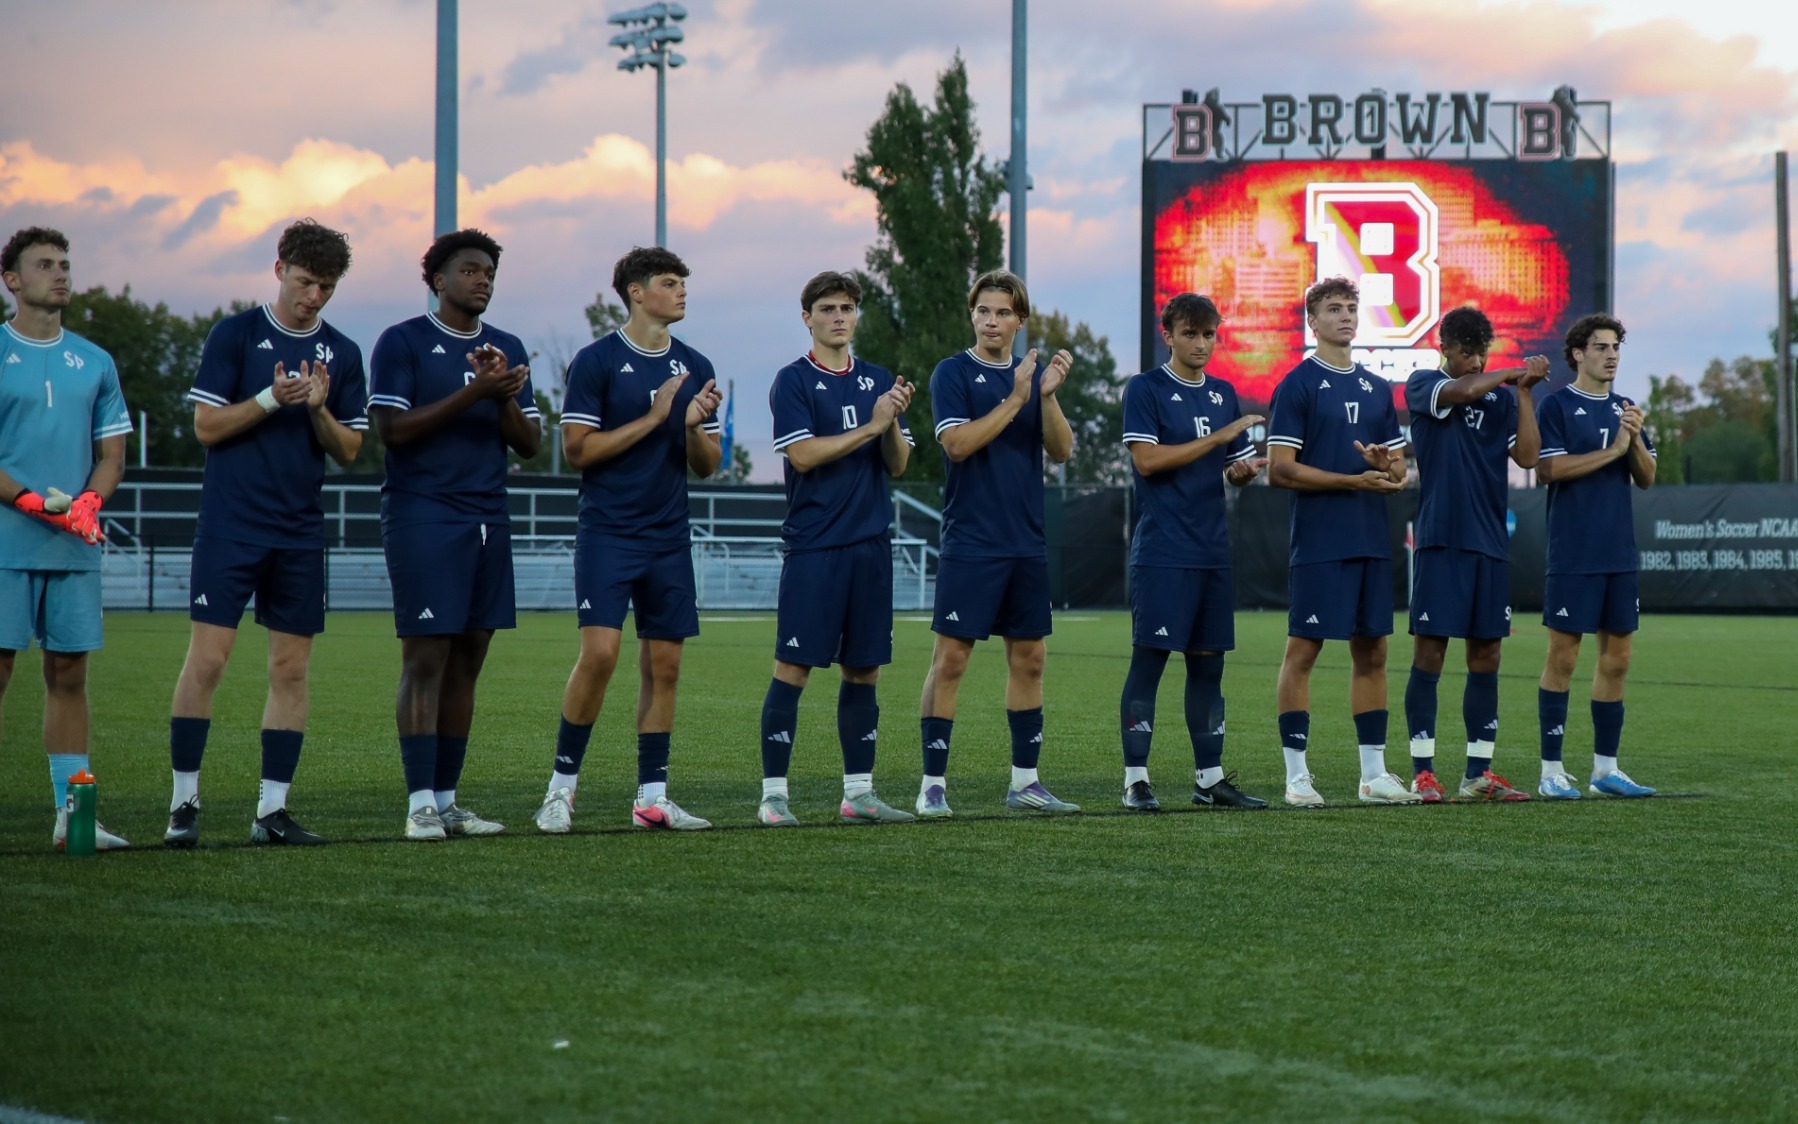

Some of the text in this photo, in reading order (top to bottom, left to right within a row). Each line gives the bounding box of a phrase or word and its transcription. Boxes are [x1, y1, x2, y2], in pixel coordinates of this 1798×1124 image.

[1260, 92, 1491, 146] BROWN
[1171, 104, 1213, 162] B
[1518, 102, 1562, 162] B
[1305, 181, 1441, 347] B
[45, 379, 53, 408] 1
[841, 404, 858, 430] 10
[1344, 401, 1359, 424] 17
[1464, 405, 1485, 430] 27
[1193, 416, 1211, 438] 16
[1599, 428, 1610, 449] 7
[1655, 520, 1714, 539] Women's
[1715, 519, 1760, 538] Soccer
[1641, 550, 1675, 571] 1982,
[1677, 550, 1712, 571] 1983,
[1713, 550, 1748, 571] 1984,
